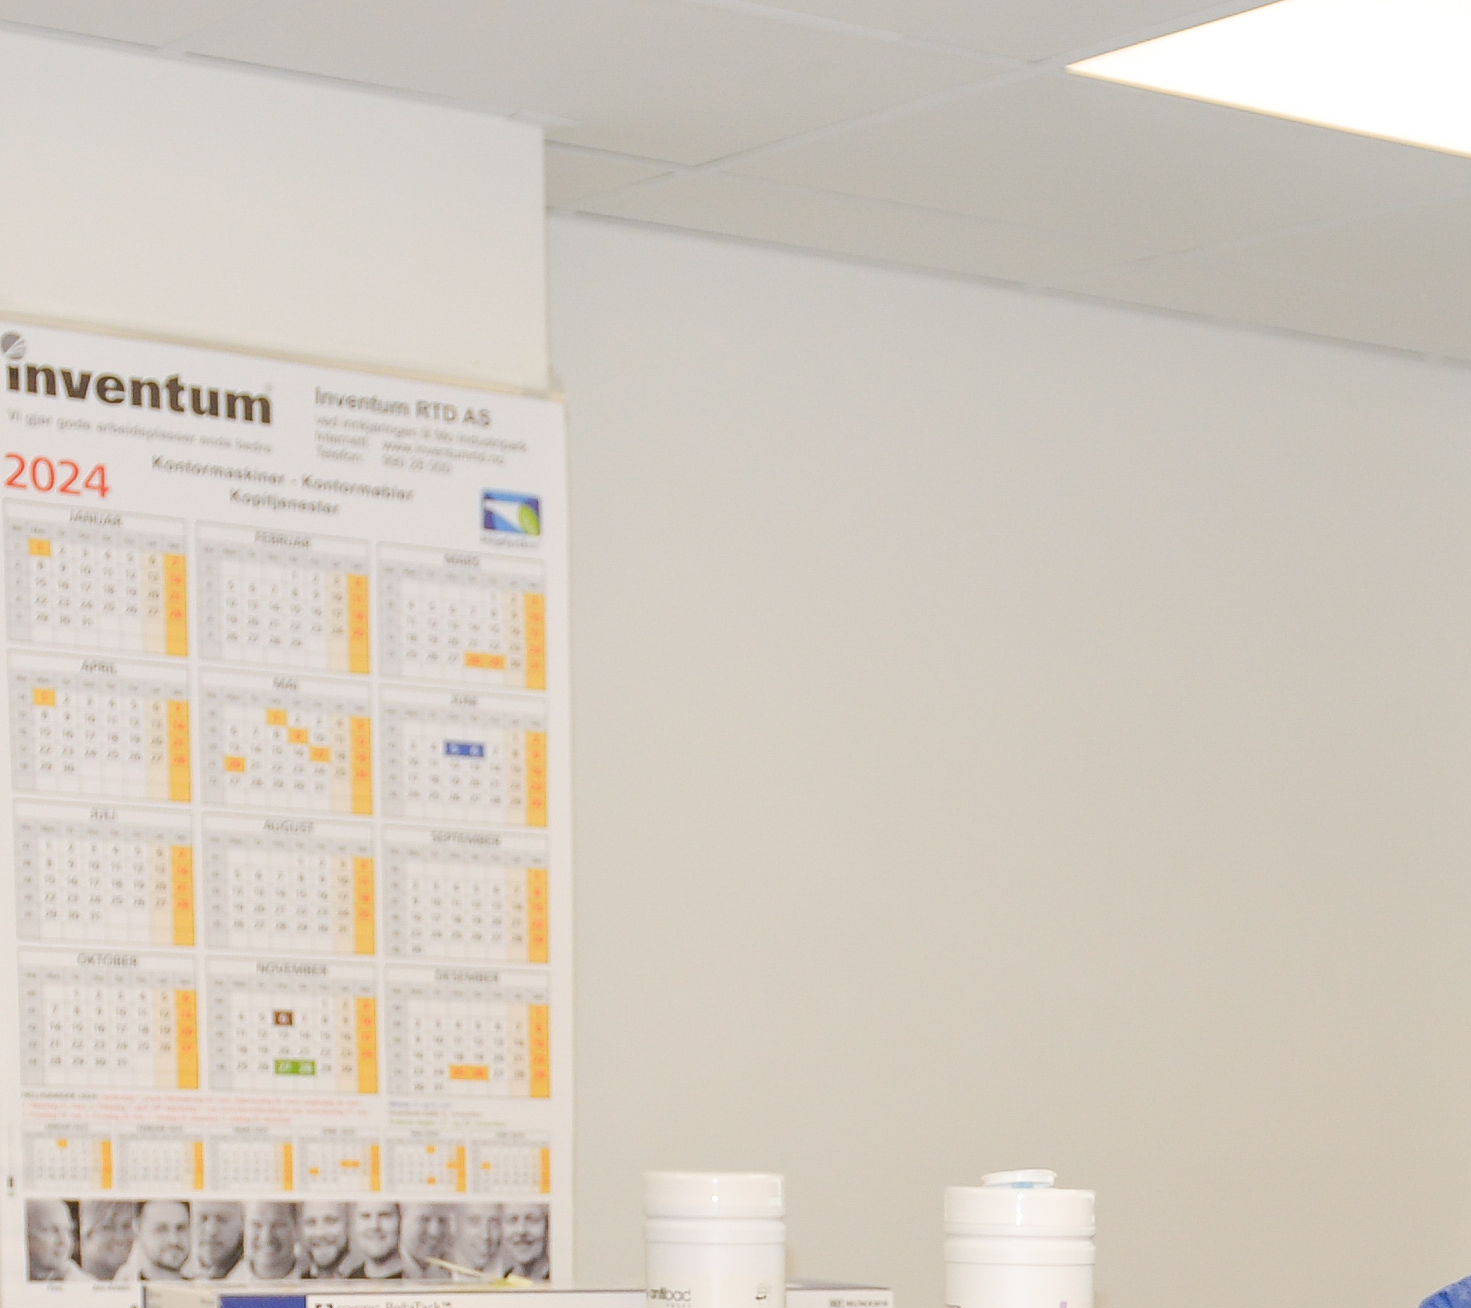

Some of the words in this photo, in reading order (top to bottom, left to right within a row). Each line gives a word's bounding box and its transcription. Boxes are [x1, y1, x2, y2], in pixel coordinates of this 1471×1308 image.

[6, 361, 273, 425] inventum
[461, 407, 492, 428] AS
[5, 452, 111, 499] 2024
